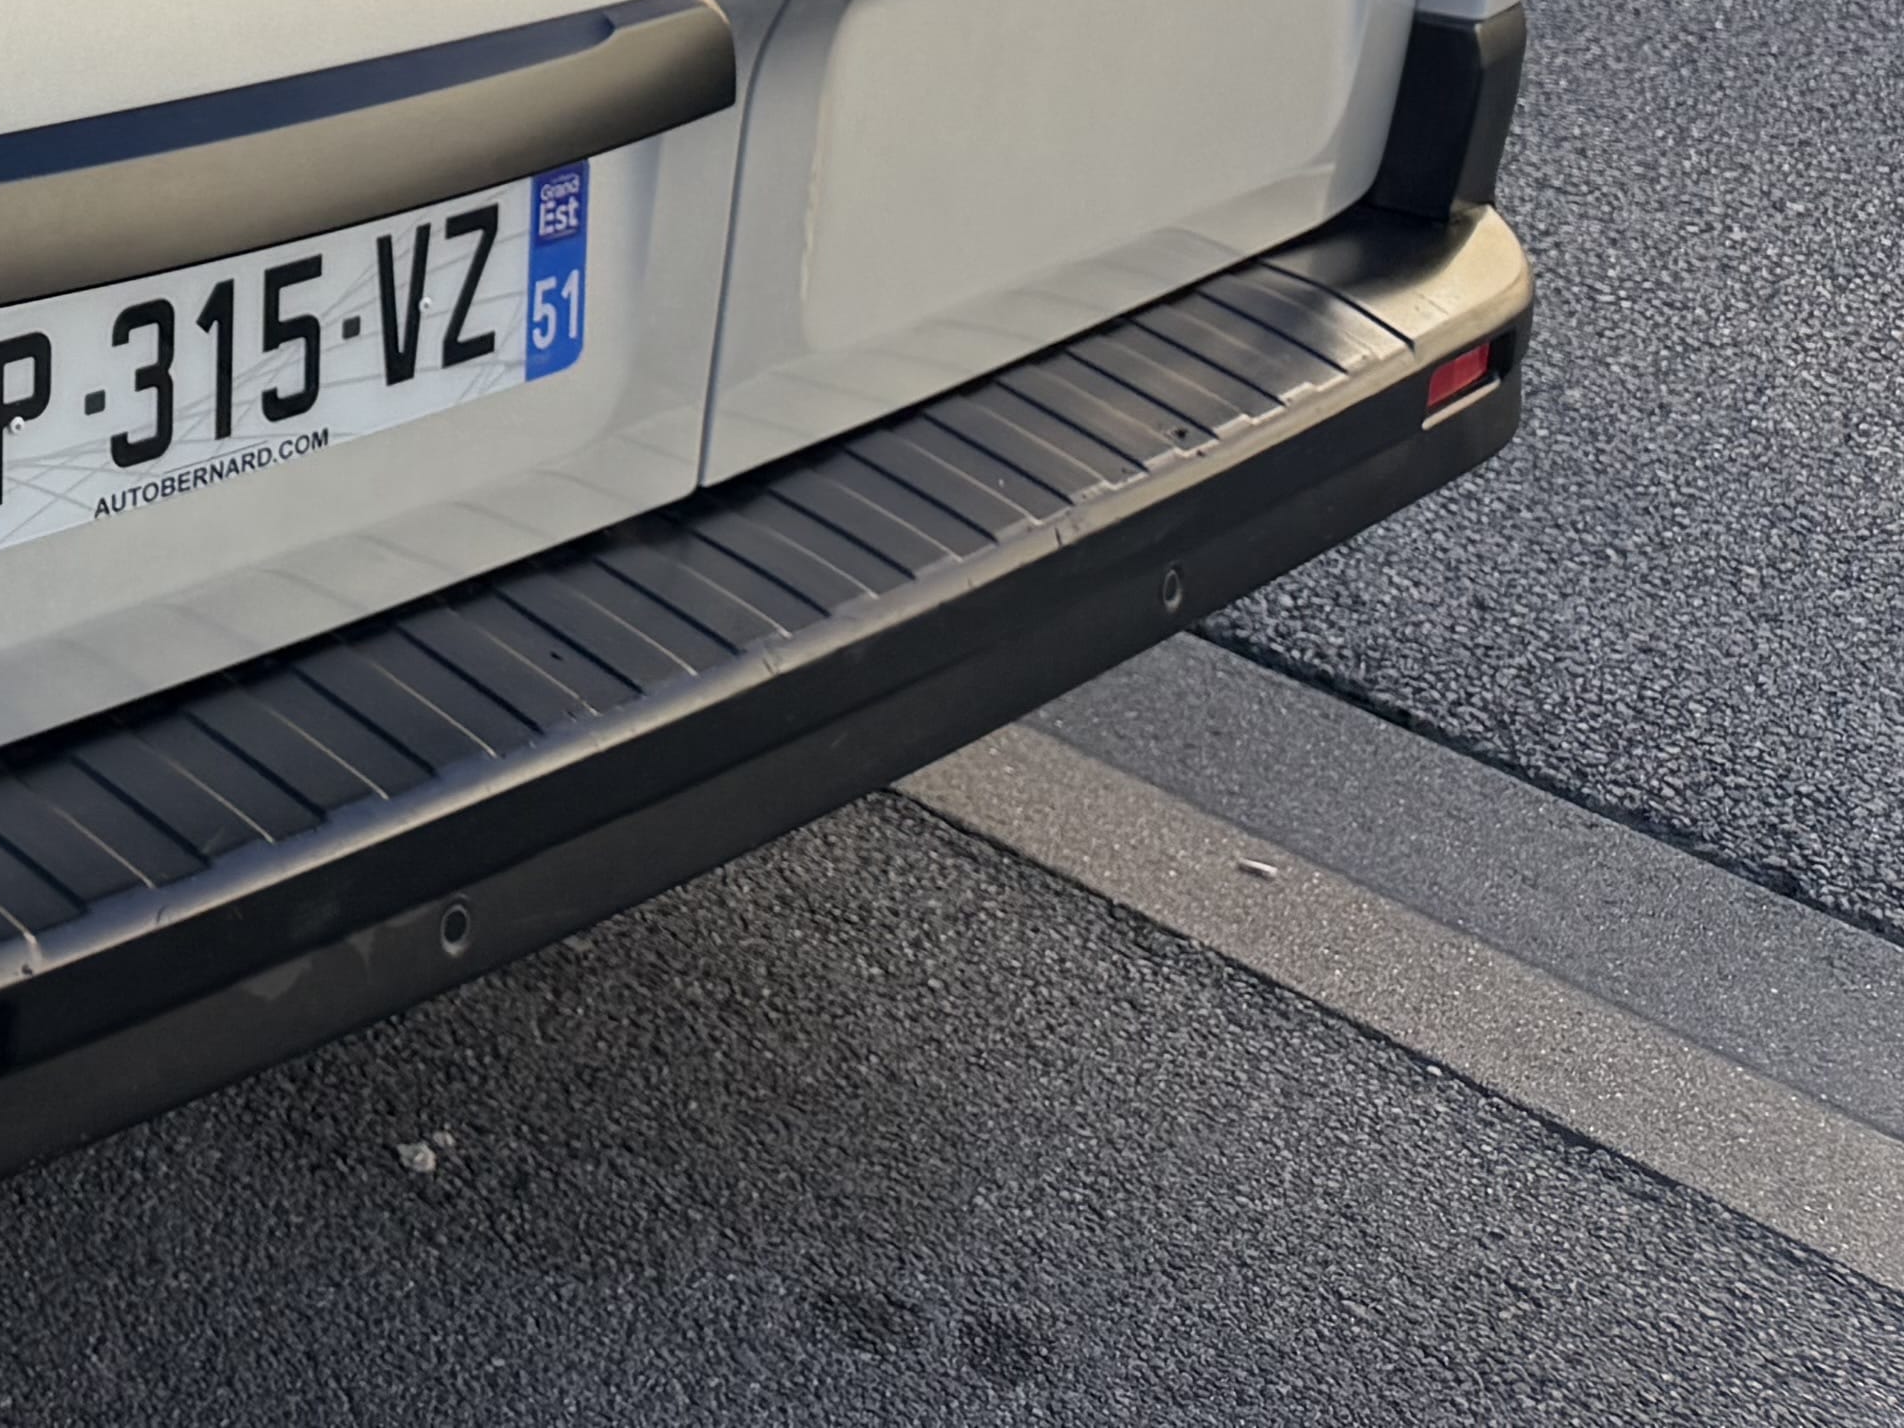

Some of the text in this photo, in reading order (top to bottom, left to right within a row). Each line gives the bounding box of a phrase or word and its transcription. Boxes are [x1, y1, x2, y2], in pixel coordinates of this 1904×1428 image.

[539, 196, 579, 236] Est
[540, 174, 580, 202] Grand
[532, 269, 580, 350] 51
[93, 428, 330, 520] AUTOBERNARD.COM
